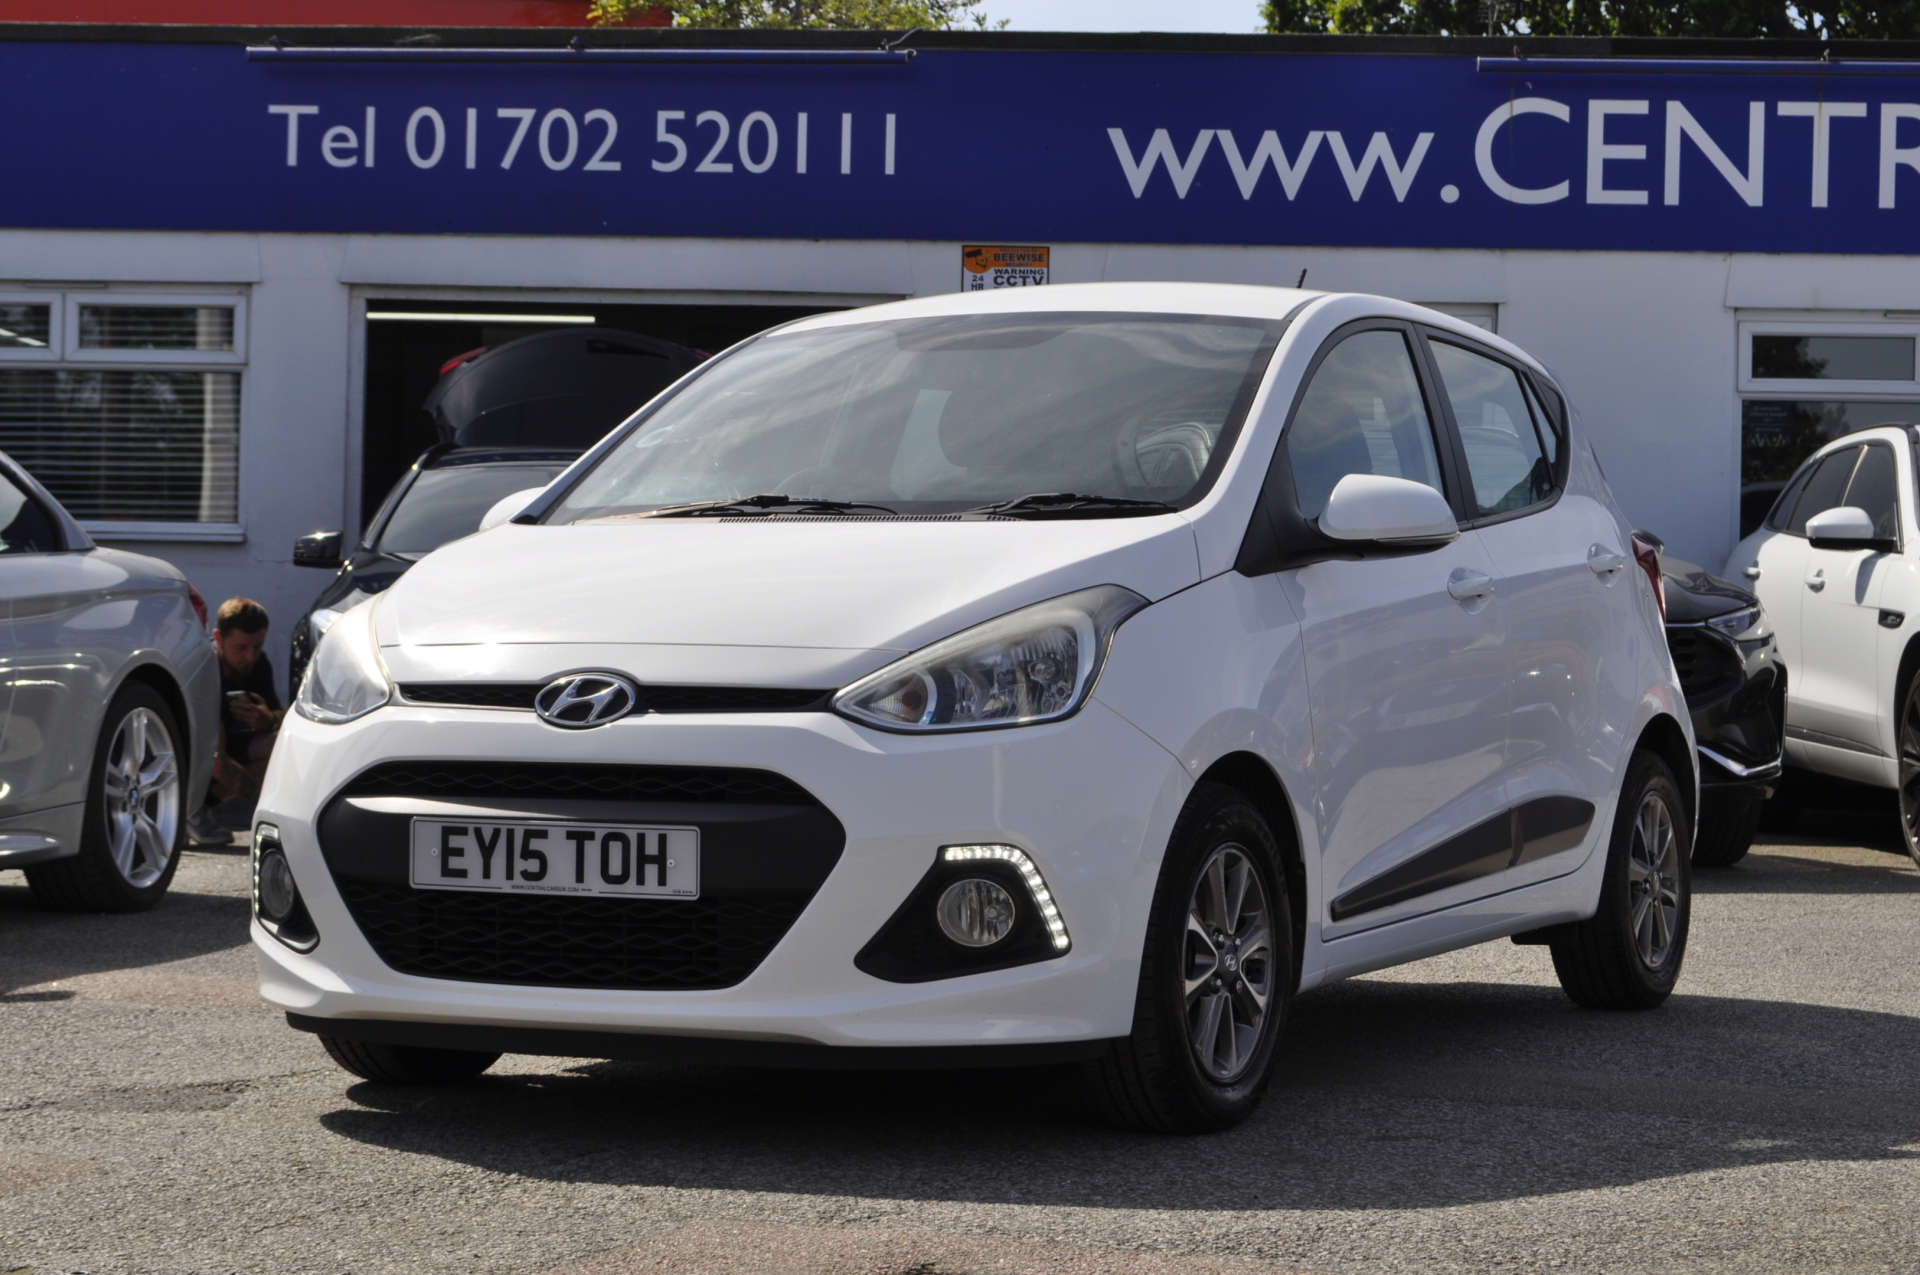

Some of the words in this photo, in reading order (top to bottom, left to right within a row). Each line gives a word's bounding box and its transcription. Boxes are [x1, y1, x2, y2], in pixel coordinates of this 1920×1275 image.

[268, 104, 376, 168] Tel
[406, 106, 622, 171] 01702
[651, 110, 896, 175] 520111
[993, 275, 1044, 286] CCTV
[440, 825, 549, 882] EY15
[566, 830, 667, 887] TOH
